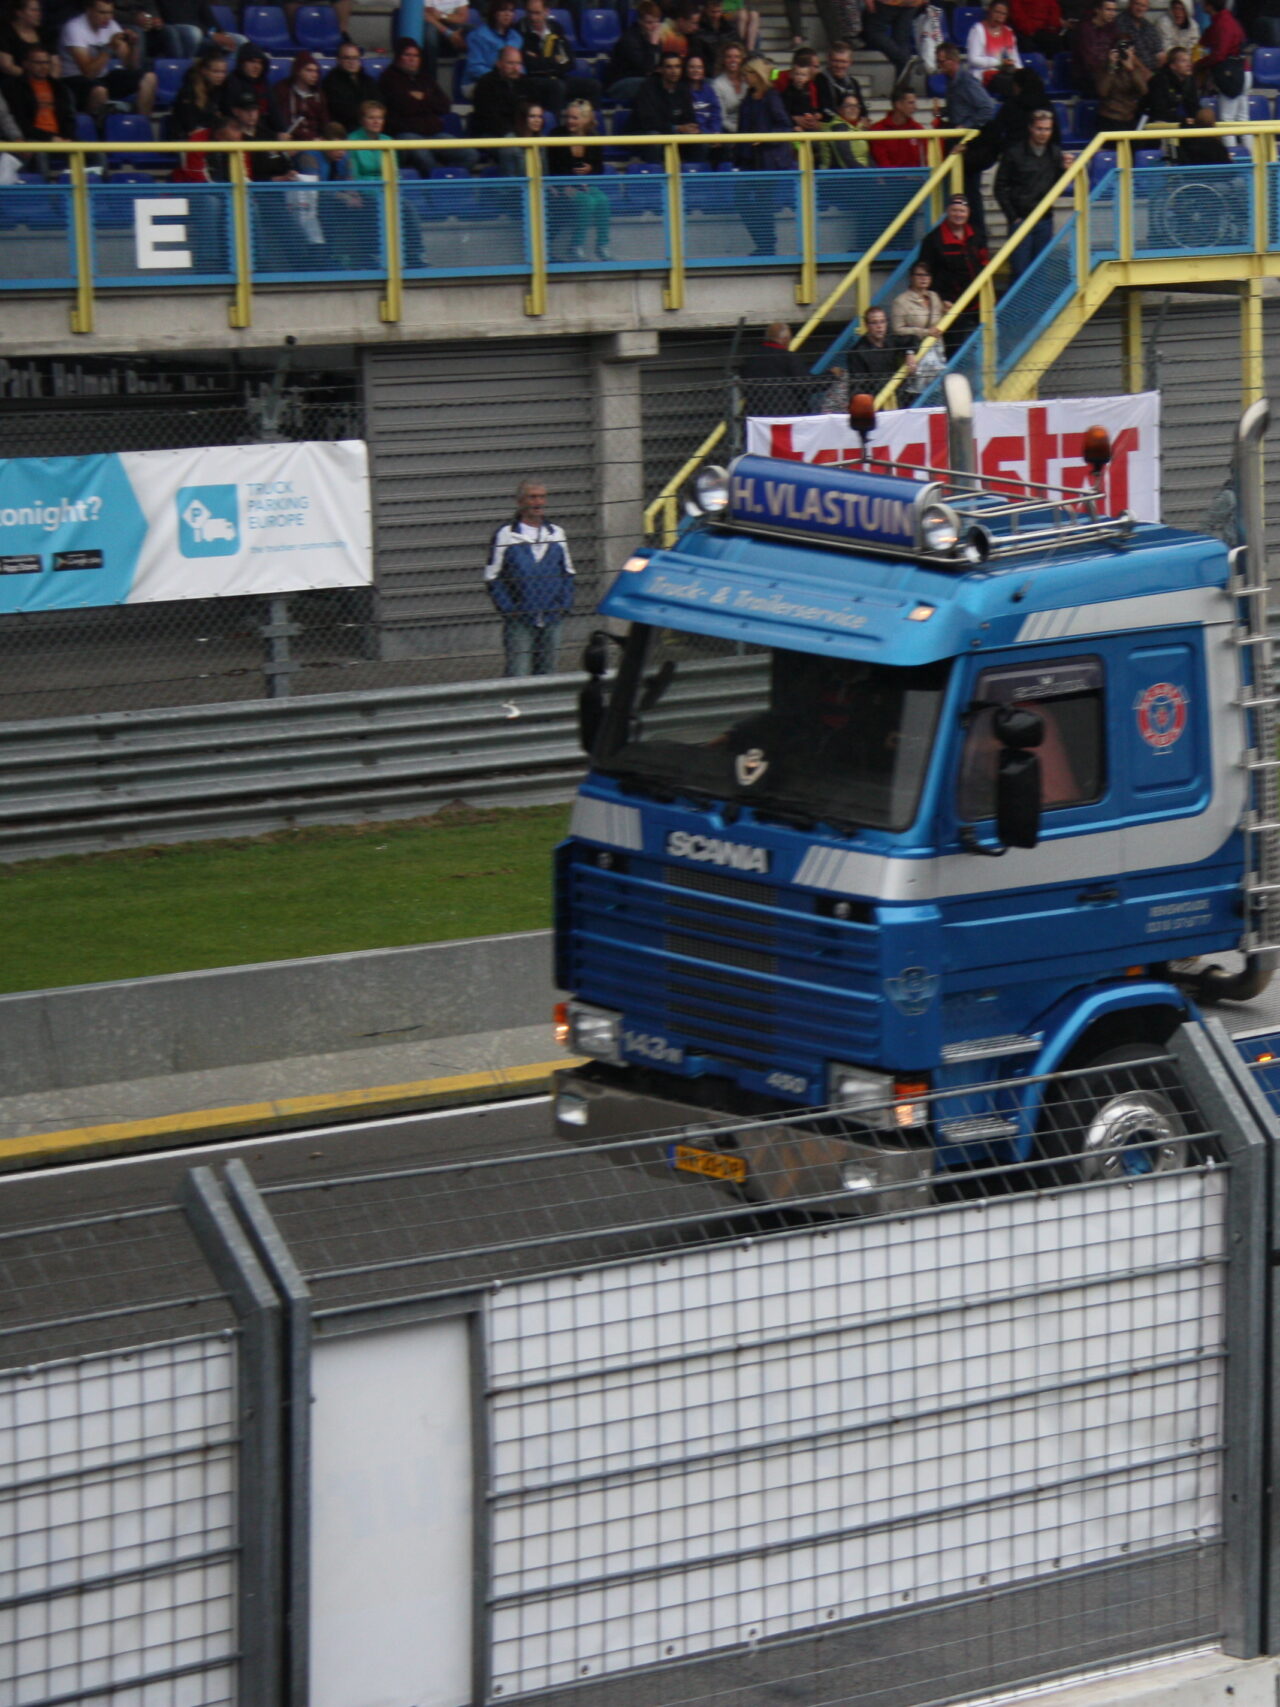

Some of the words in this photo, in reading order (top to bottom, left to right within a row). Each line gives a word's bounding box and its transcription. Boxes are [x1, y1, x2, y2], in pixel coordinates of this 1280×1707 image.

[134, 198, 192, 269] E
[245, 481, 293, 495] TRUCK
[247, 496, 311, 512] PARKING
[248, 513, 304, 529] EUROPE
[709, 586, 732, 604] &
[667, 831, 769, 873] SCANIA
